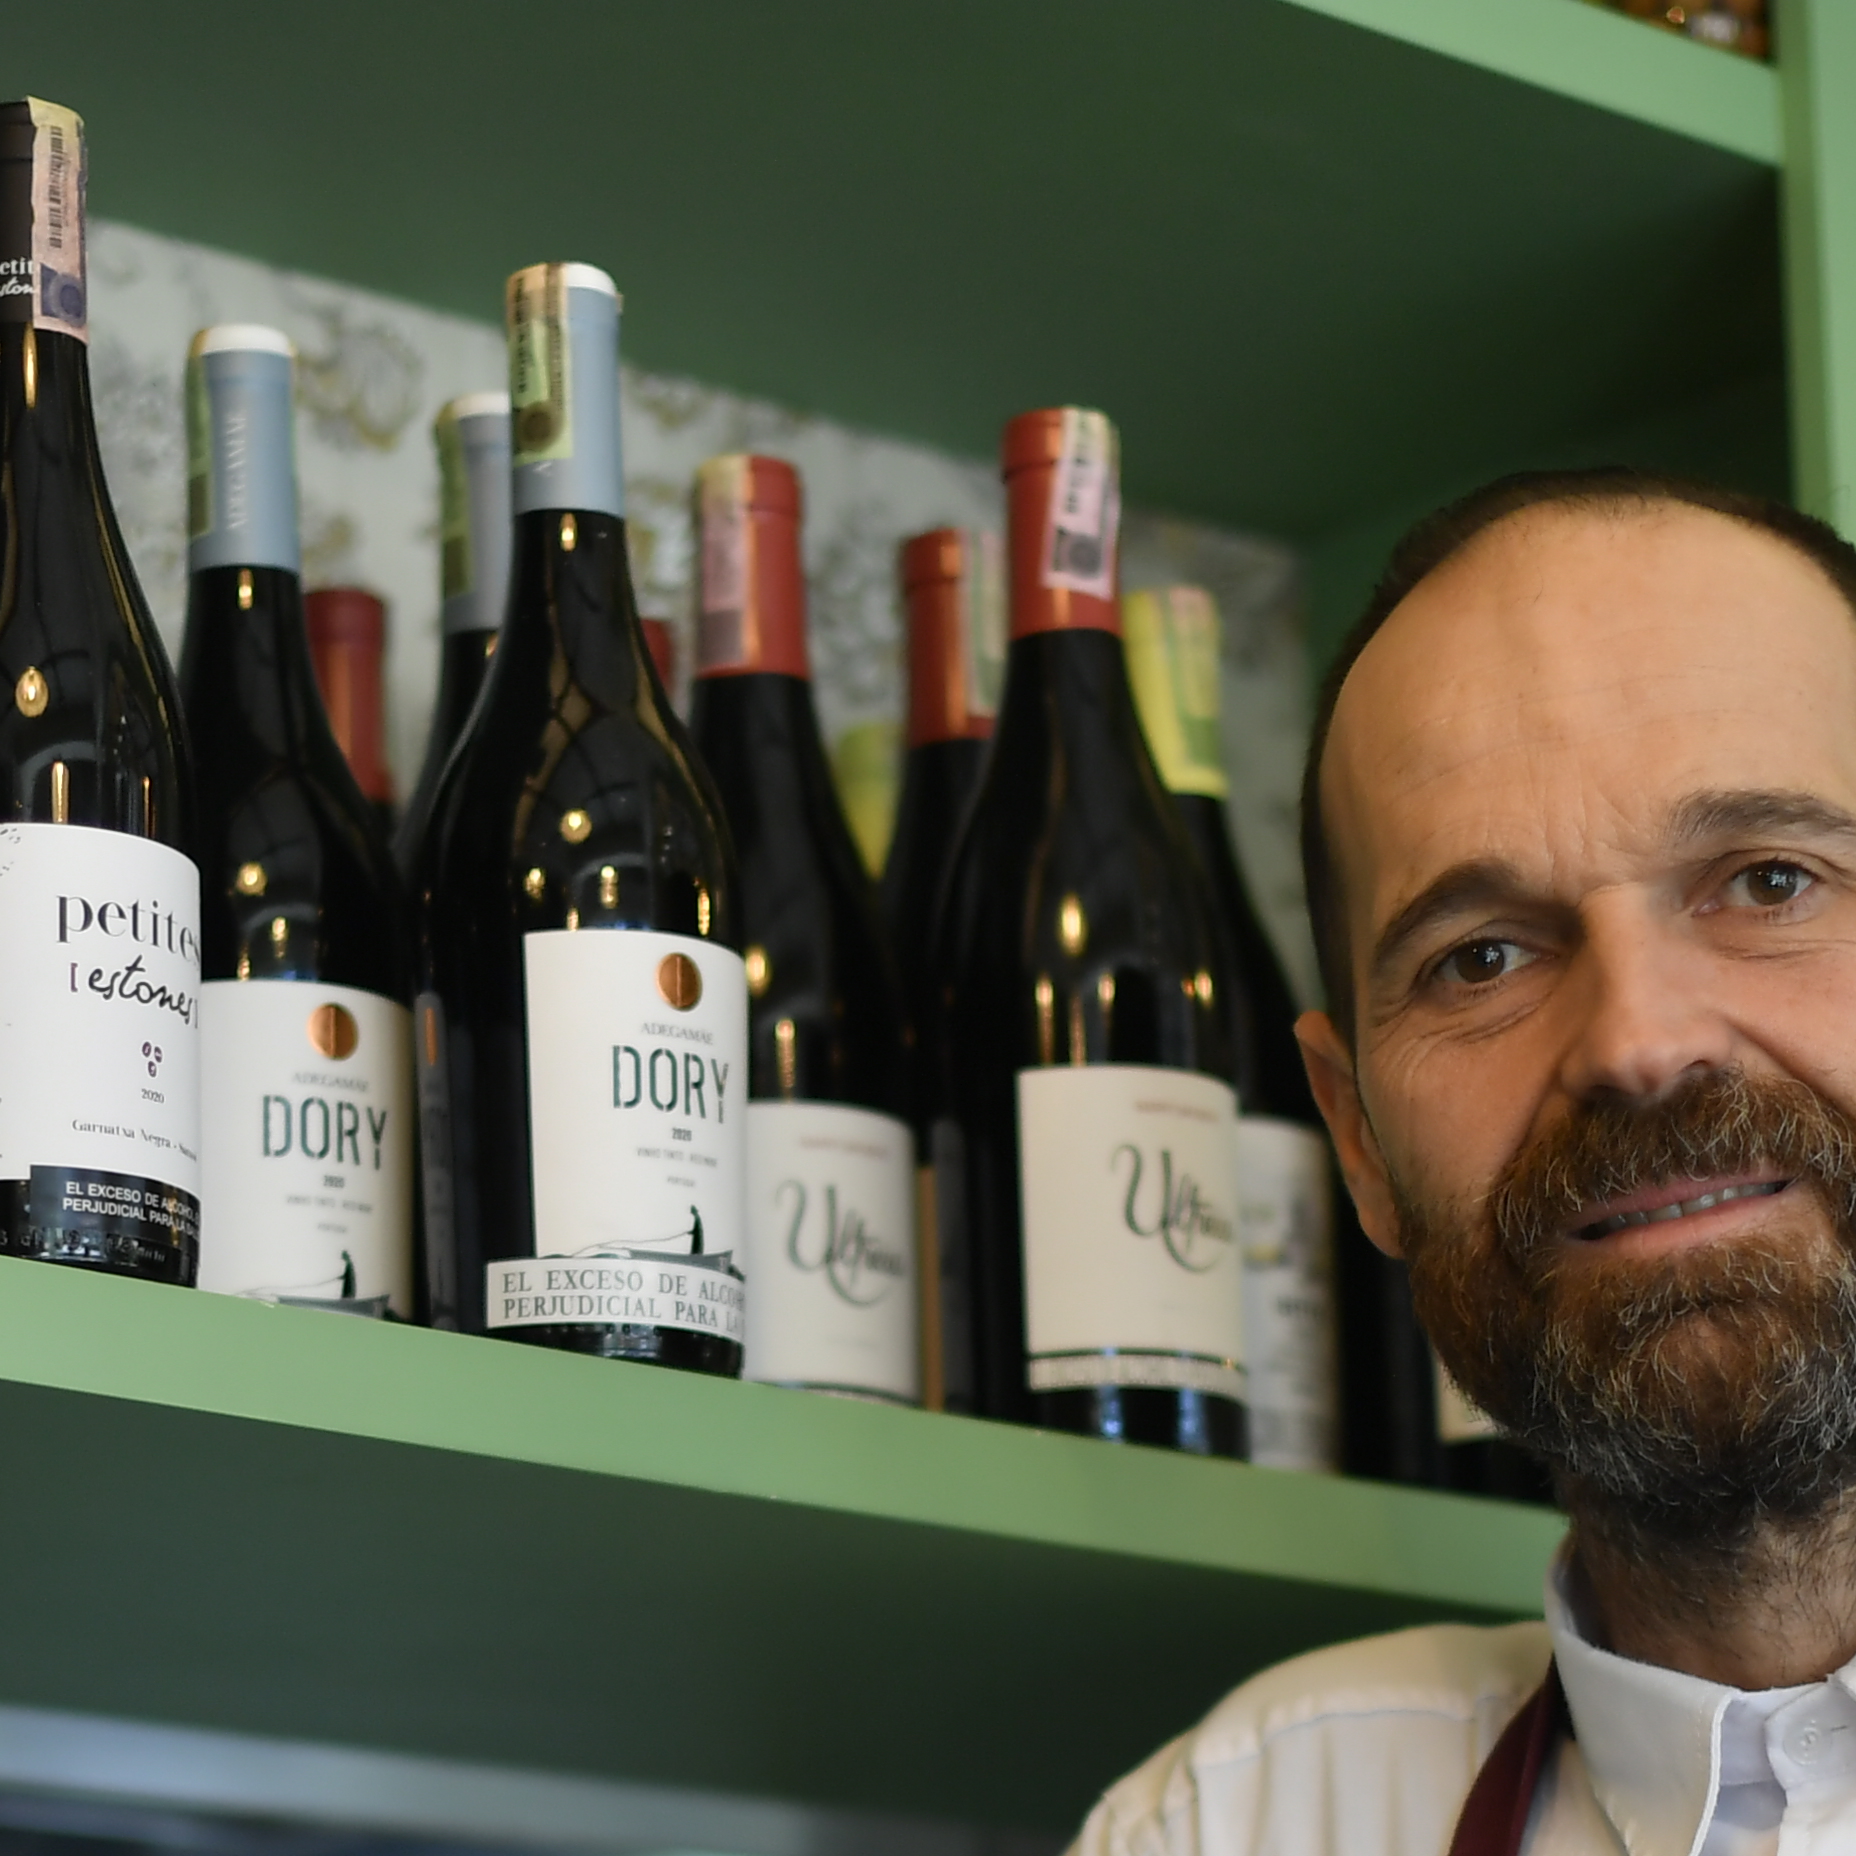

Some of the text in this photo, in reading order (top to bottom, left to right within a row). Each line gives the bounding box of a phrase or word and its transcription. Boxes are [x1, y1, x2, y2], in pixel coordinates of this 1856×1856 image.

[56, 895, 200, 970] petites
[142, 1088, 165, 1103] 2020
[612, 1045, 729, 1124] DORY
[263, 1095, 387, 1171] DORY
[66, 1181, 84, 1195] EL
[88, 1183, 142, 1203] EXCESO
[145, 1192, 160, 1208] DE
[63, 1198, 147, 1222] PERJUDICIAL
[149, 1209, 174, 1228] PARA
[503, 1271, 533, 1294] EL
[546, 1269, 643, 1293] EXCESO
[659, 1273, 688, 1296] DE
[504, 1296, 662, 1320] PERJUDICIAL
[675, 1300, 719, 1328] PARA
